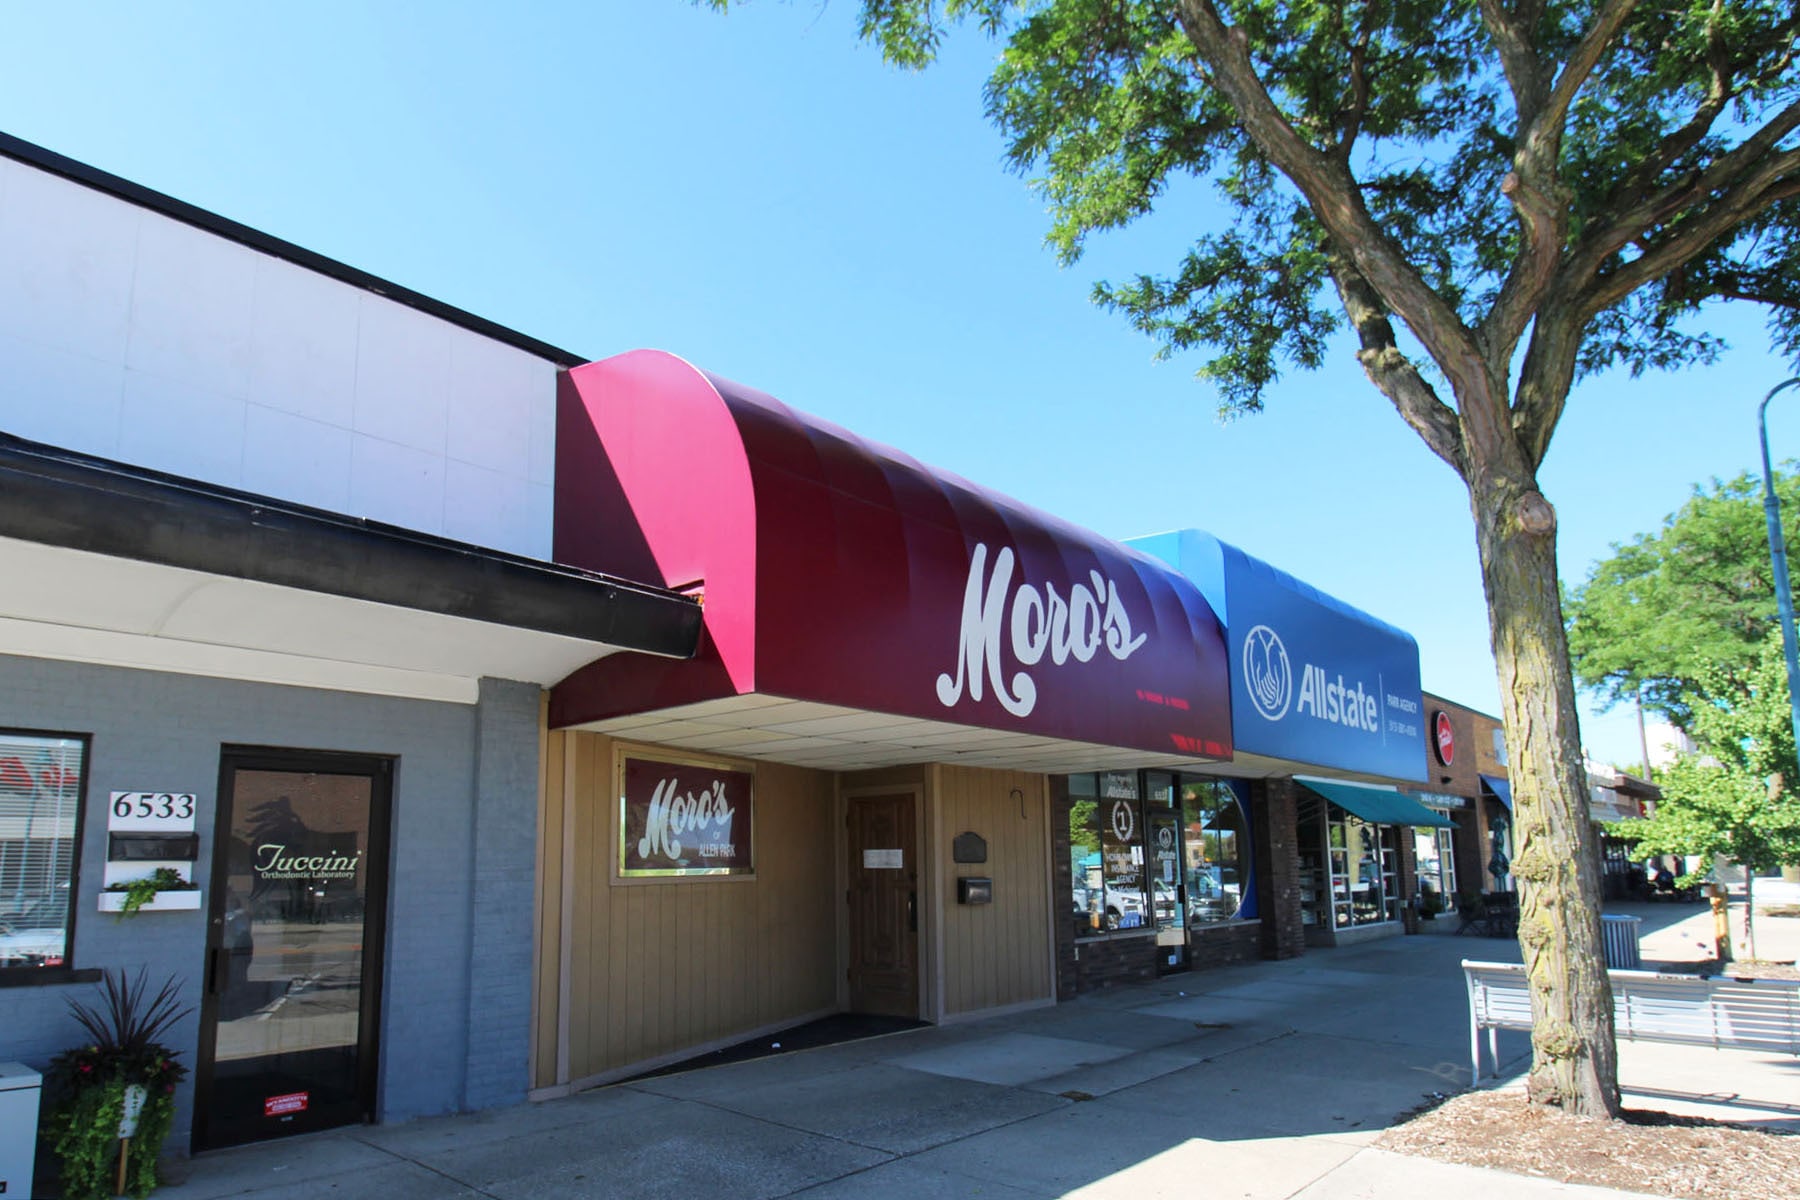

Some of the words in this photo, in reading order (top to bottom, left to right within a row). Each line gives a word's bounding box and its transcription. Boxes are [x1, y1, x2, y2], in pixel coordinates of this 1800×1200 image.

[936, 543, 1147, 717] Moro's
[1297, 663, 1377, 732] Allstate
[113, 793, 193, 818] 6533
[638, 778, 735, 860] Moro's
[254, 844, 362, 871] Tuccini
[699, 843, 719, 857] ALLEN
[719, 843, 736, 857] PARK
[261, 871, 310, 879] Orthodontic
[312, 871, 355, 879] Laboratory
